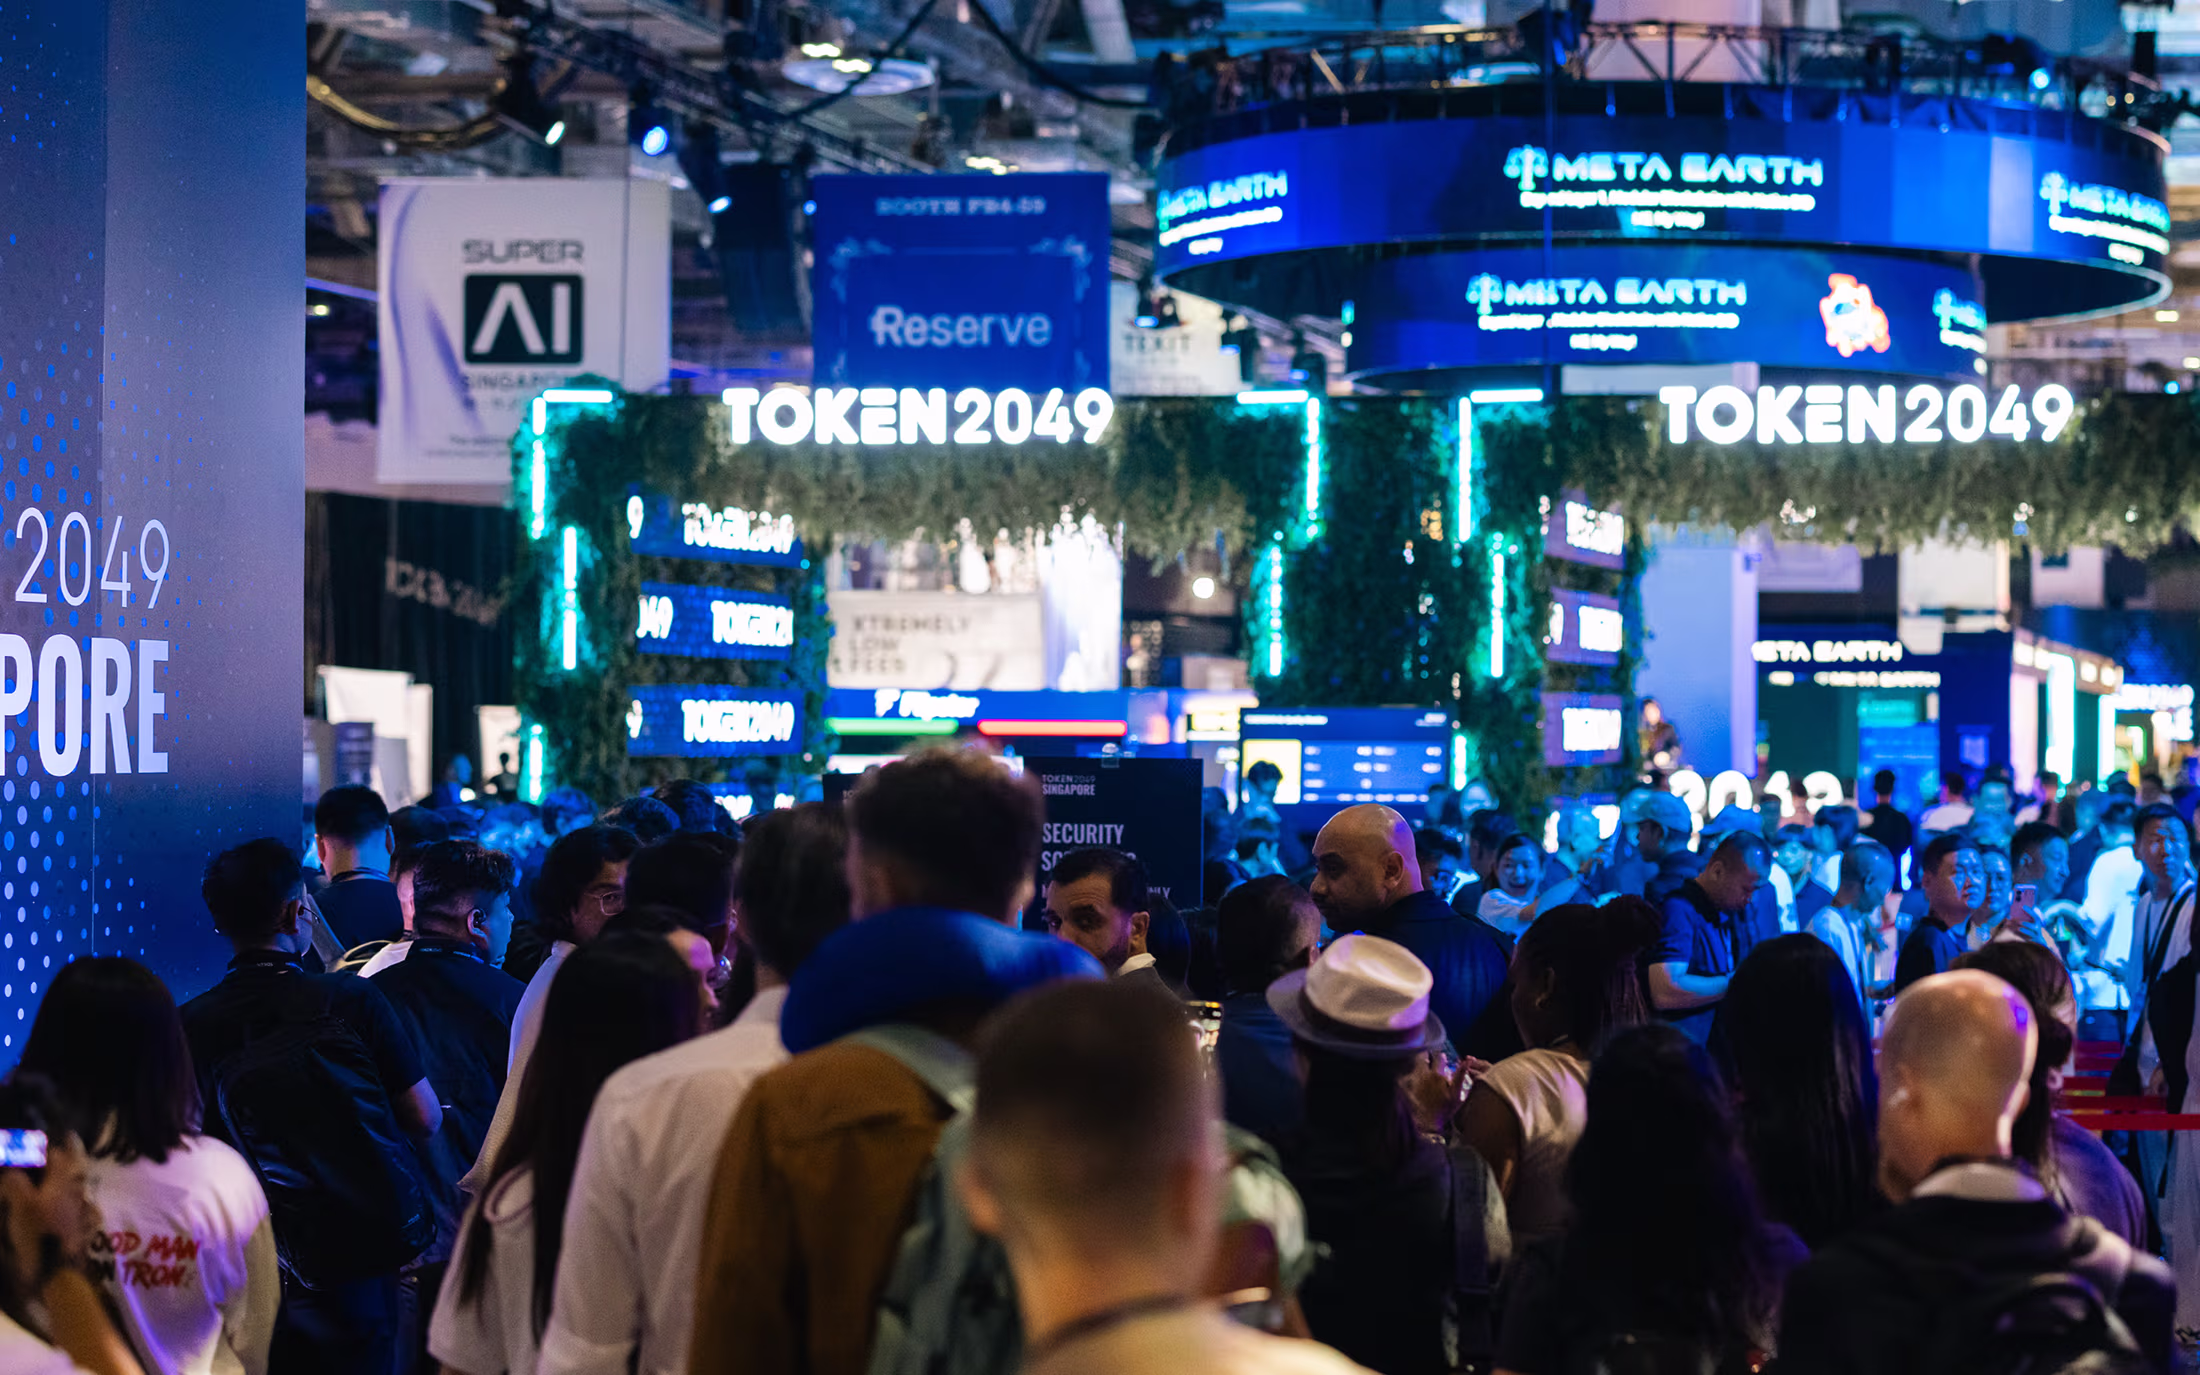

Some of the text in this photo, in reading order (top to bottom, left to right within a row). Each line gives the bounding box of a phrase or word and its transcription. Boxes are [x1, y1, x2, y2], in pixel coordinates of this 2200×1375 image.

[1552, 152, 1823, 187] META EARTH
[462, 239, 584, 264] SUPER
[1614, 278, 1748, 306] EARTH
[870, 306, 1053, 347] Reserve
[722, 387, 1115, 446] TOKEN2049
[1659, 383, 2075, 445] TOKEN2049
[15, 507, 170, 609] 2049
[1042, 774, 1097, 783] TOKEN2049
[1042, 784, 1096, 795] SINGAPORE
[1042, 823, 1124, 844] SECURITY
